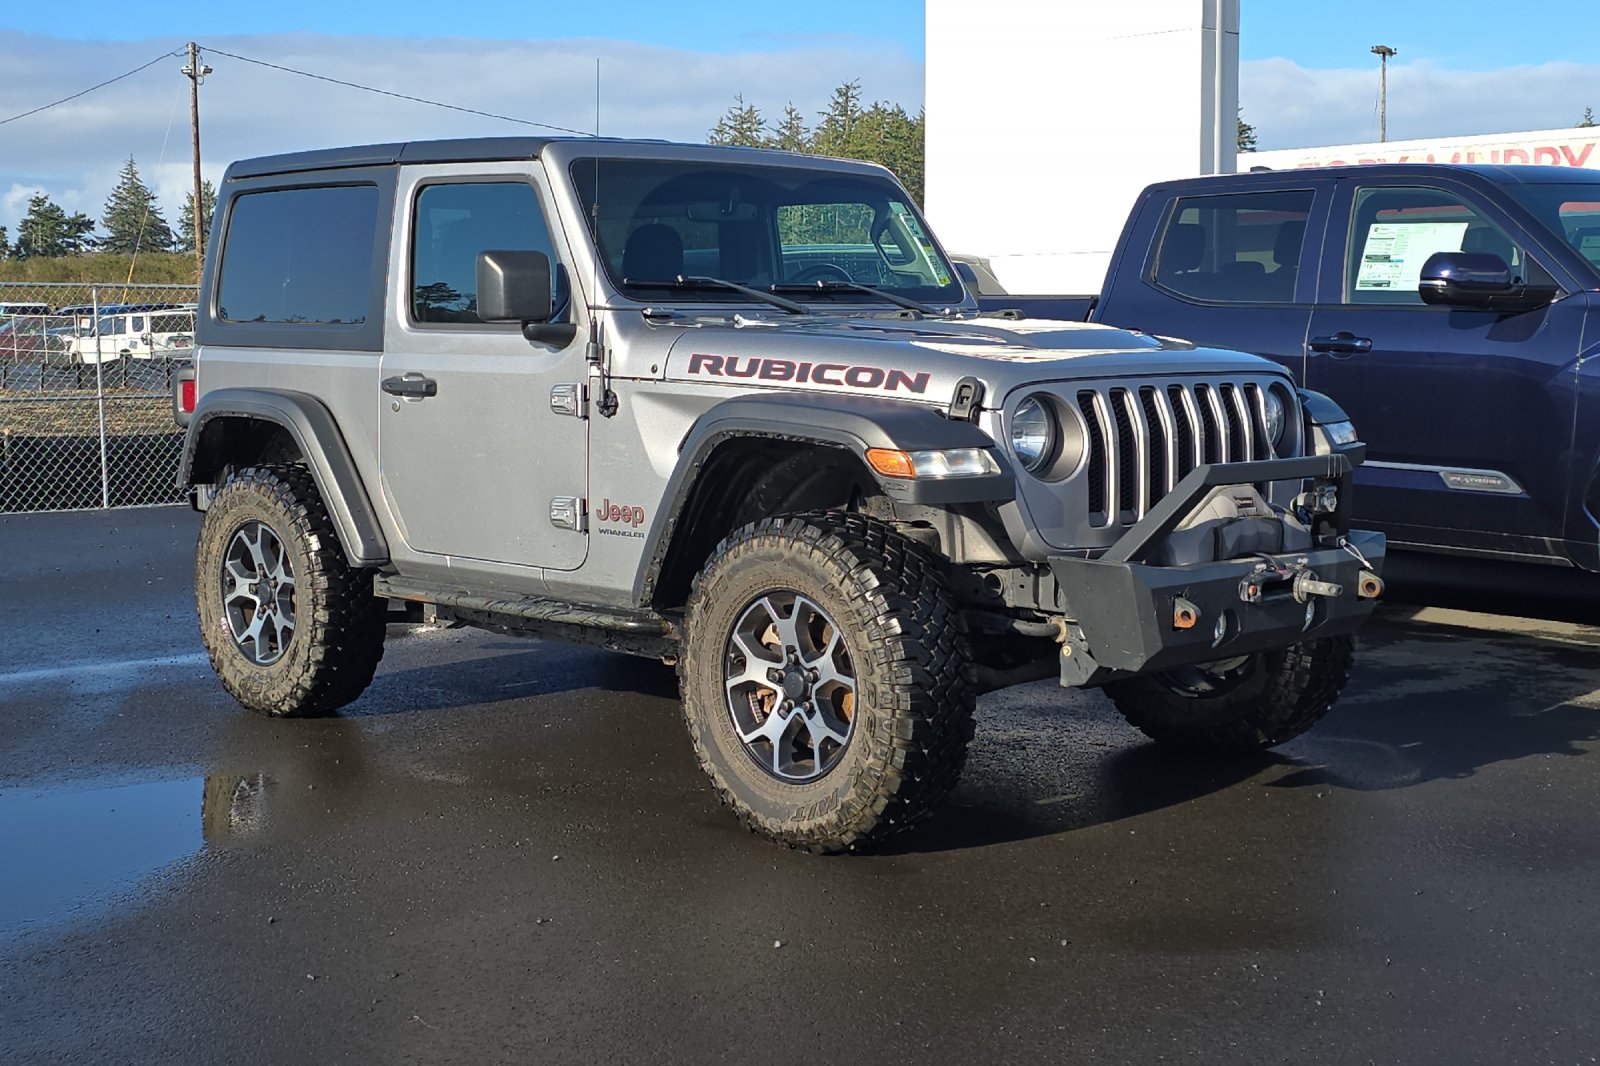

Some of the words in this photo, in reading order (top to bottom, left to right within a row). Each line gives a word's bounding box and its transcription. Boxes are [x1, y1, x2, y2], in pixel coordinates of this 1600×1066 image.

[687, 353, 931, 394] RUBICON
[596, 498, 645, 528] Jeep
[598, 528, 645, 539] WRANGLER
